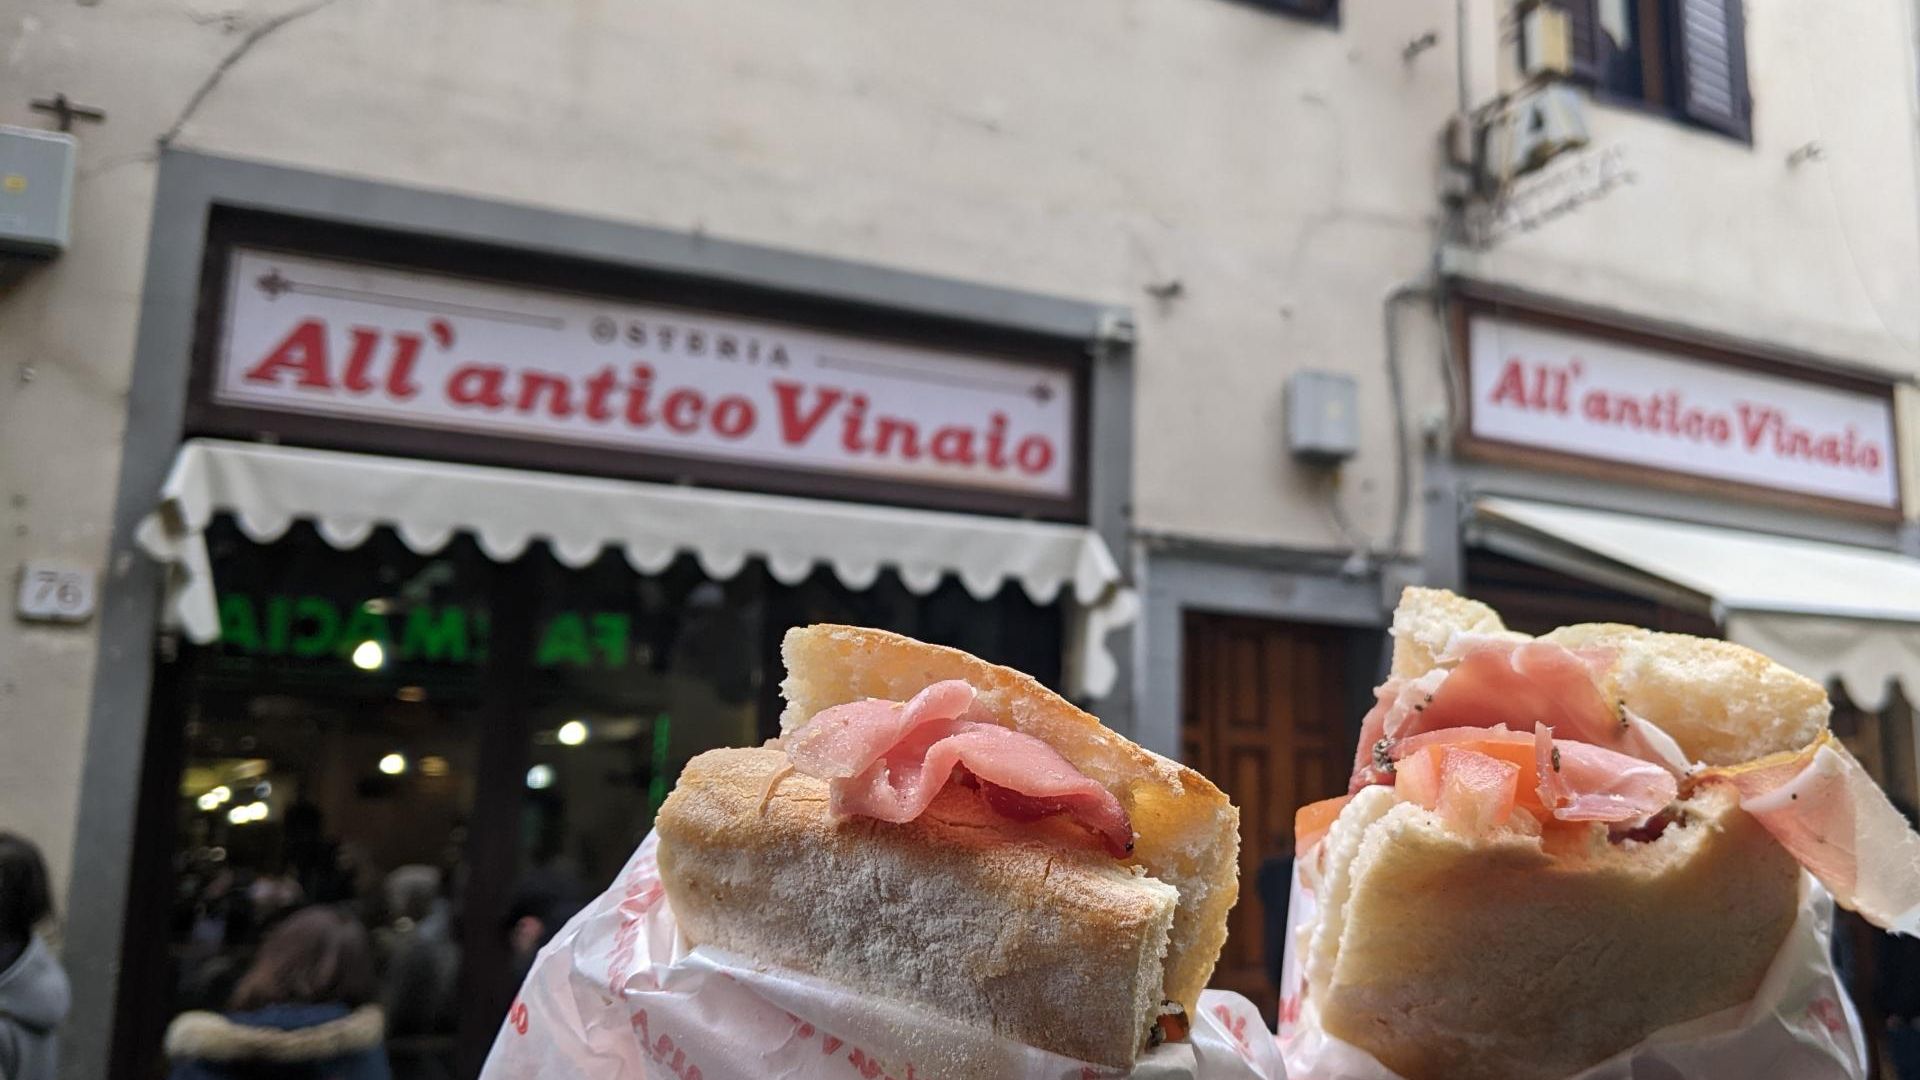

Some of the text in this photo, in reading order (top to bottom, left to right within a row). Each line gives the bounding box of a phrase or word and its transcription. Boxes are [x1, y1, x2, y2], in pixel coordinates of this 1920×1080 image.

[590, 315, 790, 369] OSTERIA
[775, 382, 1053, 475] Vinaio
[1738, 403, 1881, 473] Vinaio
[36, 571, 83, 610] 76
